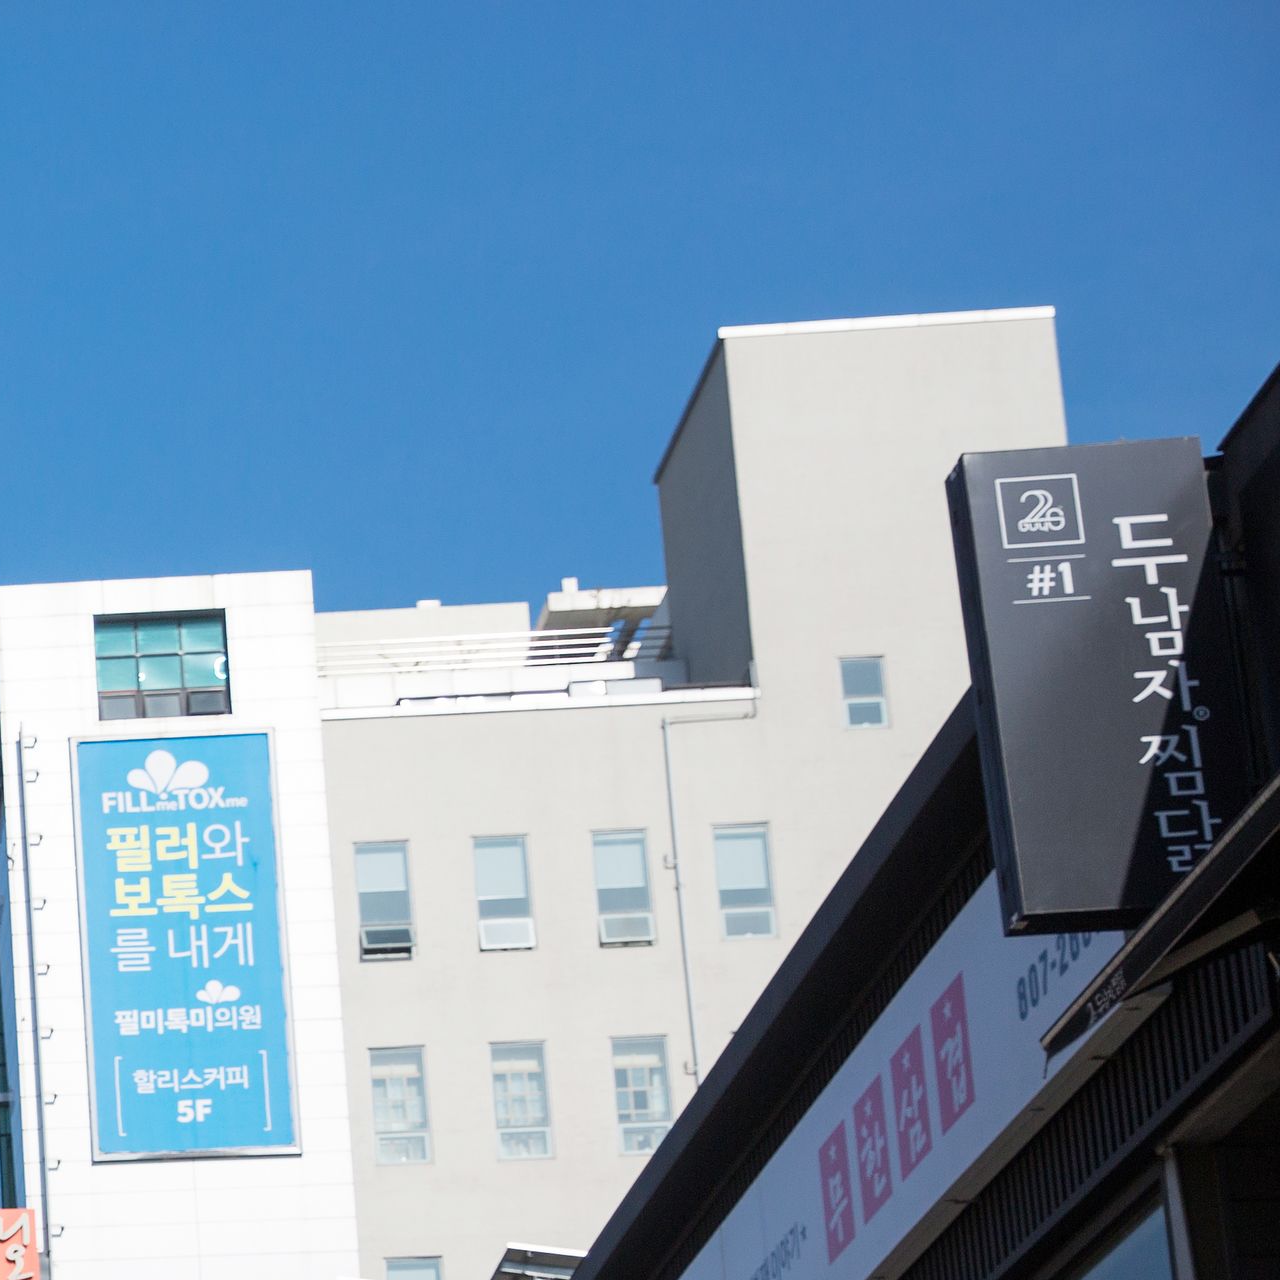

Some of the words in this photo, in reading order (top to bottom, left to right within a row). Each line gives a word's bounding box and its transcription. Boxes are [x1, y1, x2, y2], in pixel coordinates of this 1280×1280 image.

[1027, 563, 1074, 596] #1
[1111, 514, 1200, 712] 두남자
[106, 821, 250, 873] 필러와
[109, 873, 254, 919] 보톡스
[110, 928, 156, 972] 를
[168, 923, 255, 968] 내게
[114, 1005, 262, 1035] 필미톡미의원
[132, 1065, 249, 1093] 할리스커피
[176, 1099, 212, 1123] 5F
